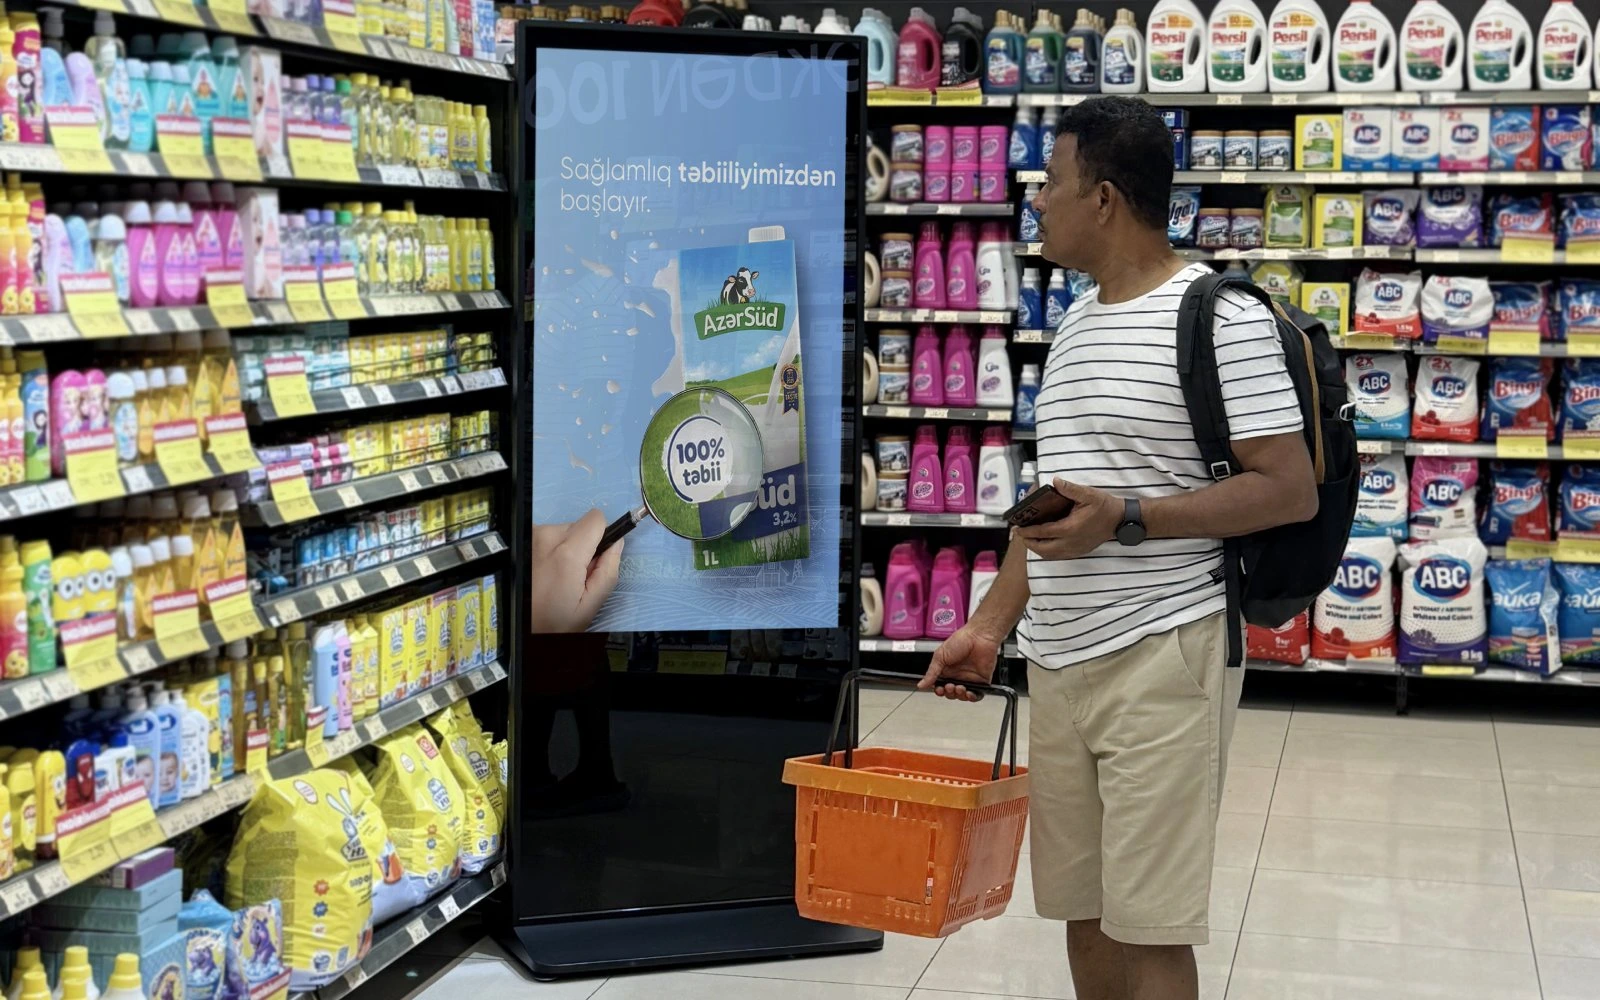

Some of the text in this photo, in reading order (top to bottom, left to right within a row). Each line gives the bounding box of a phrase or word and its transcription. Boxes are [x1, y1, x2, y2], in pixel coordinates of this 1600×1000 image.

[1151, 31, 1186, 44] Persil
[1212, 31, 1247, 44] Persil
[1273, 30, 1307, 43] Persil
[1340, 27, 1376, 42] Persil
[1407, 27, 1444, 39] Persil
[1475, 28, 1513, 40] Persil
[1544, 33, 1577, 44] Persil
[1356, 129, 1381, 141] ABC
[1405, 129, 1429, 141] ABC
[1454, 128, 1477, 140] ABC
[560, 156, 836, 190] Sağlamlıq təbiiliyimizdən
[560, 188, 651, 218] başlayır.
[1374, 202, 1400, 217] ABC
[1377, 286, 1401, 298] ABC
[1447, 292, 1470, 304] ABC
[704, 306, 779, 335] AzərSüd
[1362, 375, 1388, 391] ABC
[1435, 381, 1464, 394] ABC
[676, 436, 725, 464] 100%
[1363, 474, 1393, 489] ABC
[752, 474, 796, 511] üd
[1426, 484, 1460, 500] ABC
[772, 510, 797, 527] 3,2%
[1332, 565, 1378, 589] ABC
[1420, 566, 1468, 589] ABC
[1412, 612, 1436, 620] Whites
[1470, 649, 1484, 662] kg
